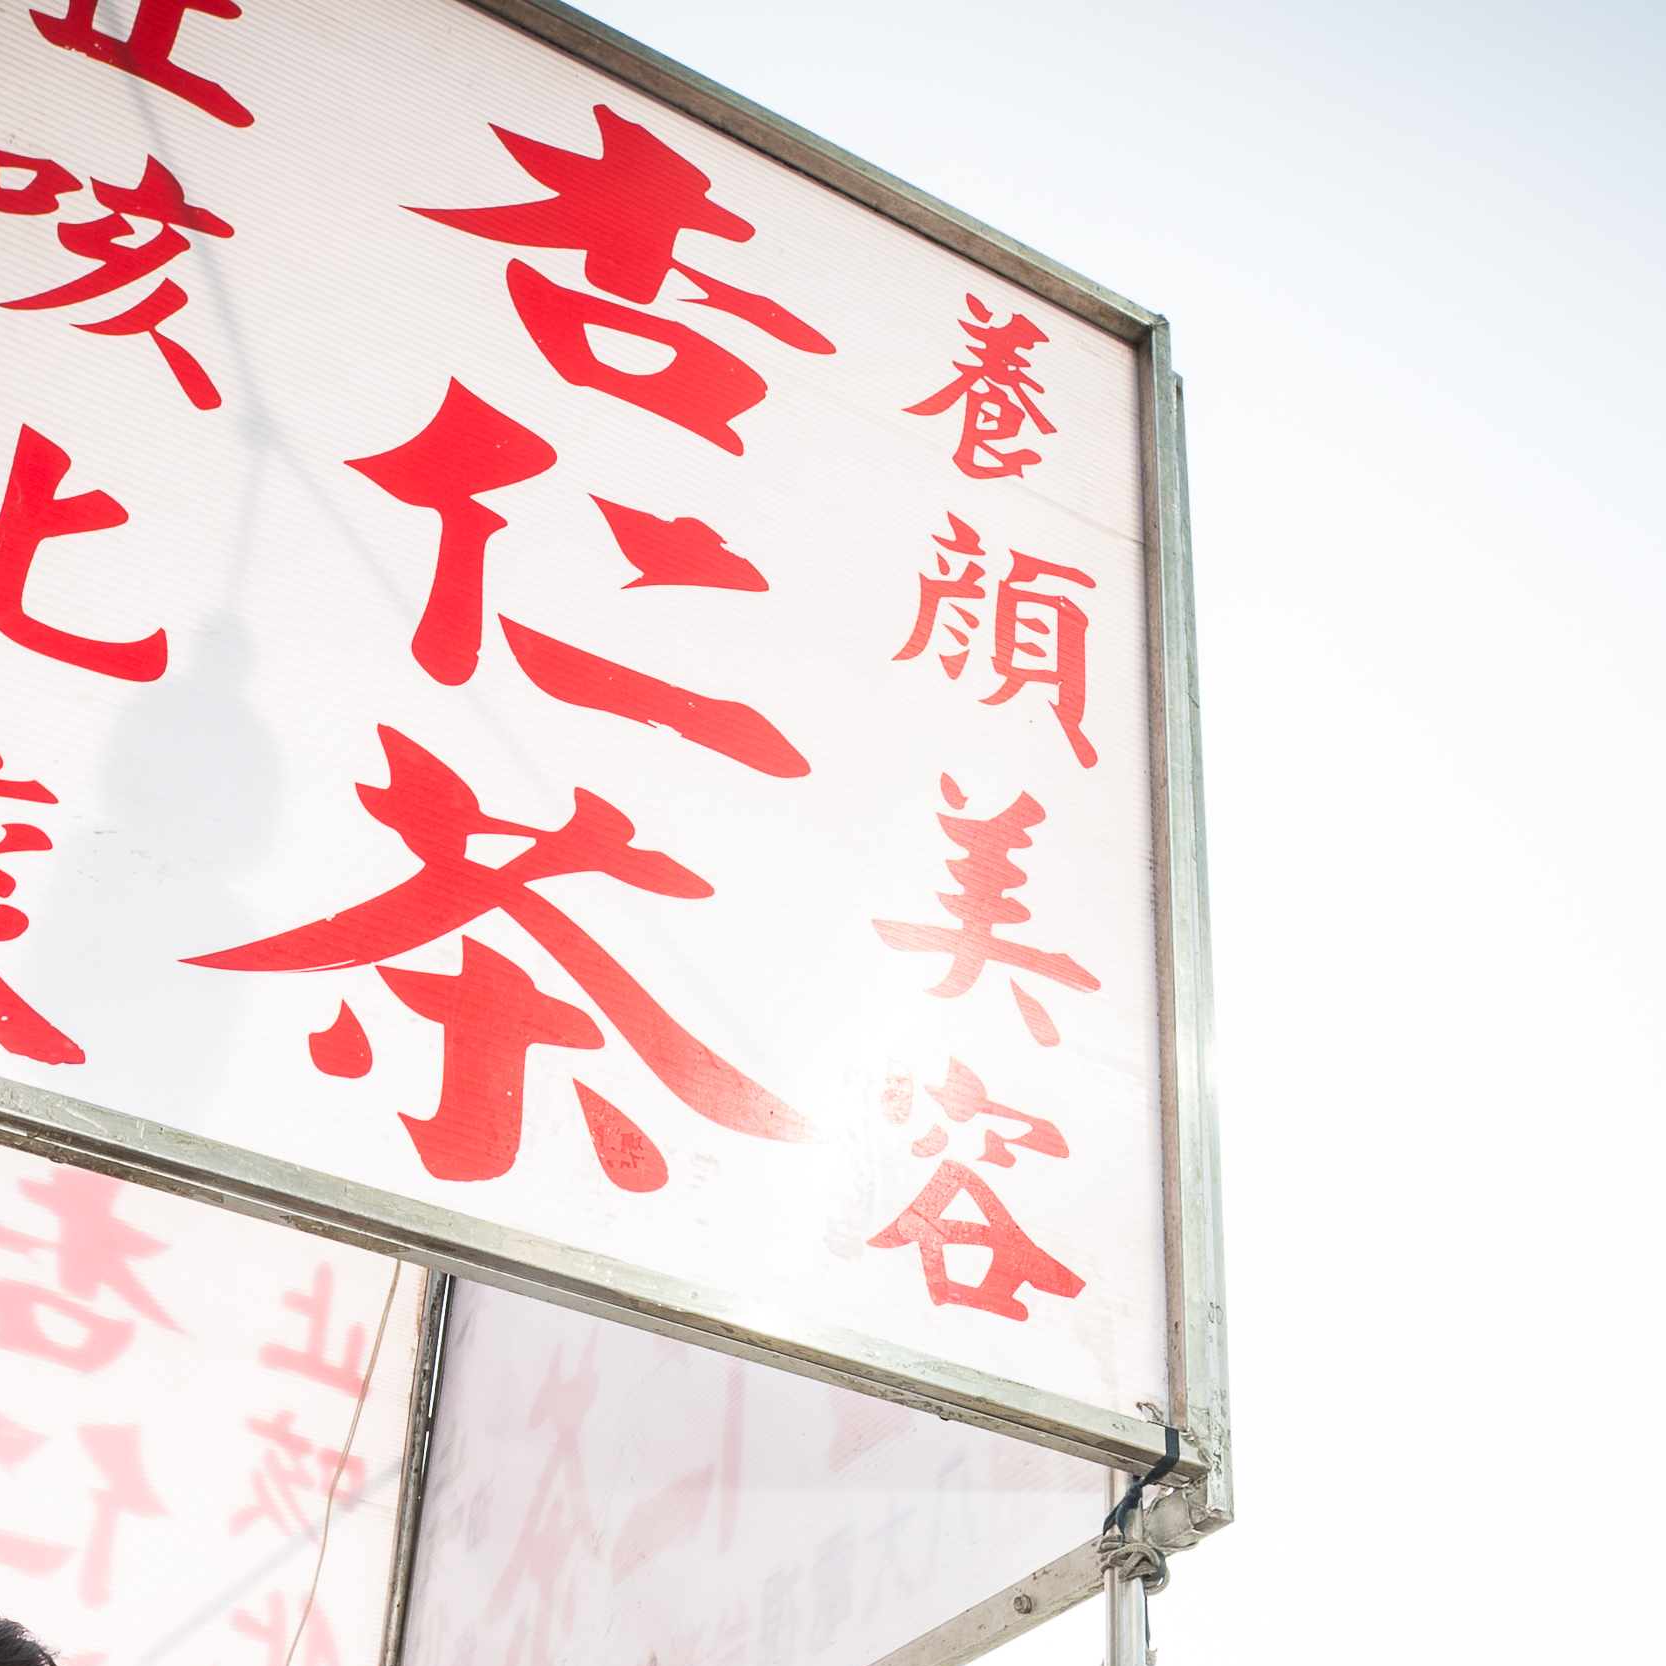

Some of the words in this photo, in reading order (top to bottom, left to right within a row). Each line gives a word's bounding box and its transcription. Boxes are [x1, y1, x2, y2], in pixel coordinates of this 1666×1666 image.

[178, 103, 838, 1193] 杏仁茶
[865, 292, 1103, 1322] 養顏美容
